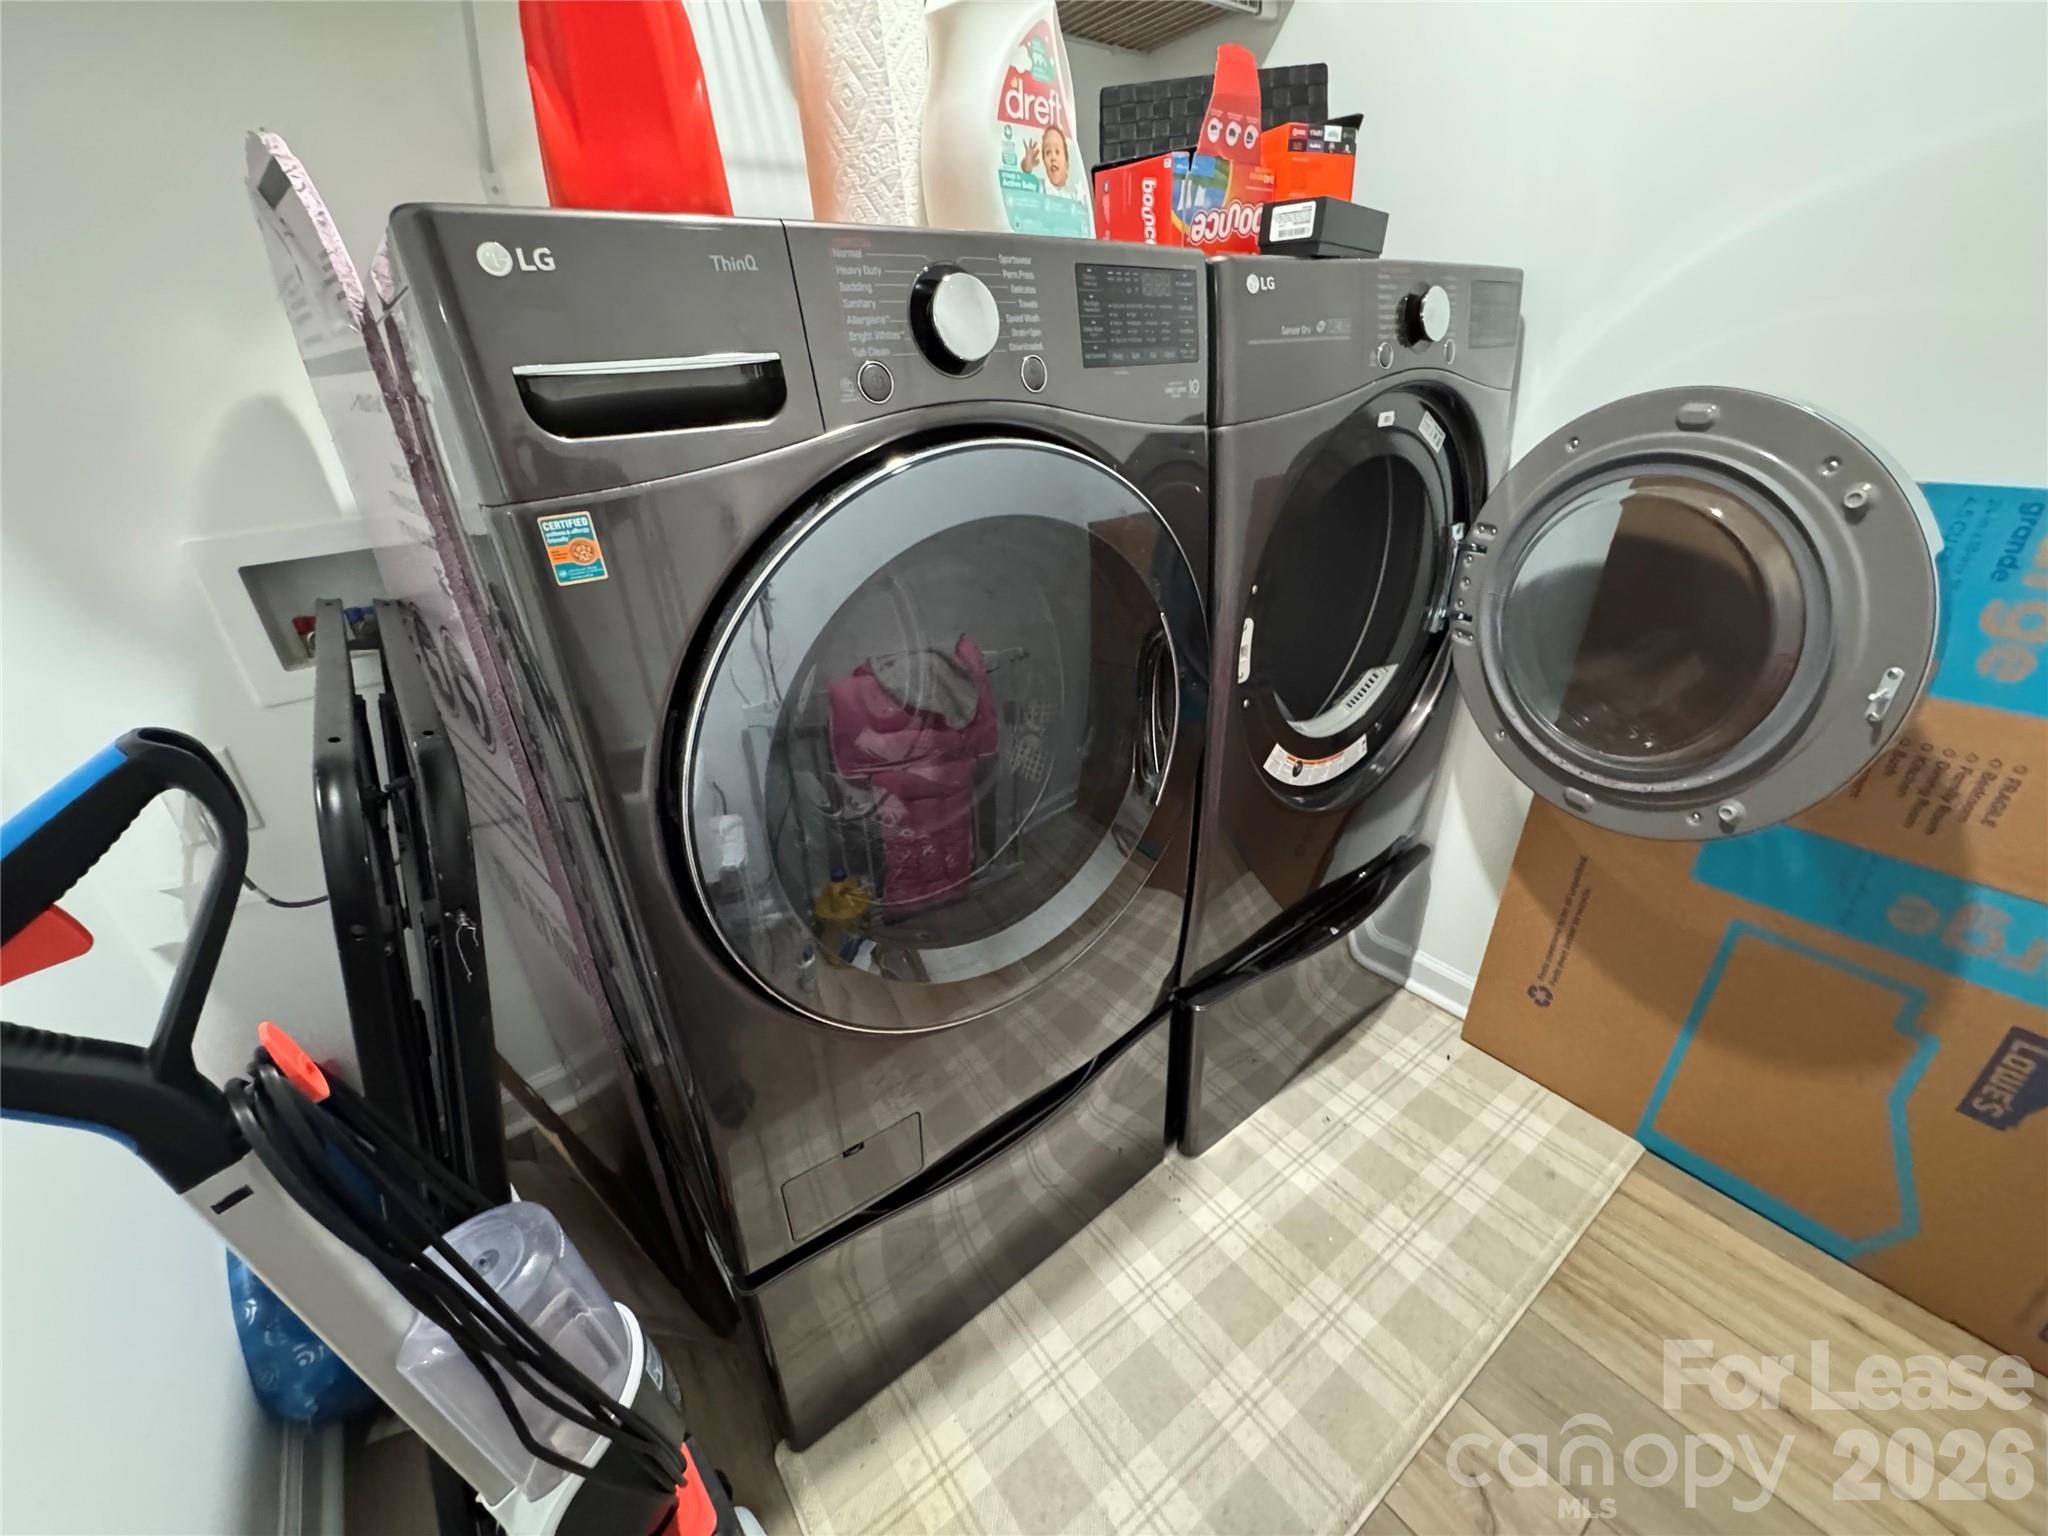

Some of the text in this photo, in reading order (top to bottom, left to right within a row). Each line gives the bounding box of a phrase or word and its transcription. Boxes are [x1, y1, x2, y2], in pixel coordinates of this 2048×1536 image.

[1004, 79, 1063, 128] dreft
[515, 247, 556, 271] LG
[709, 254, 759, 272] ThinQ
[836, 264, 881, 277] Heavy Duty
[542, 517, 588, 531] CERTIFIED
[1991, 501, 2044, 582] grande
[1980, 777, 2022, 828] FRAGILE
